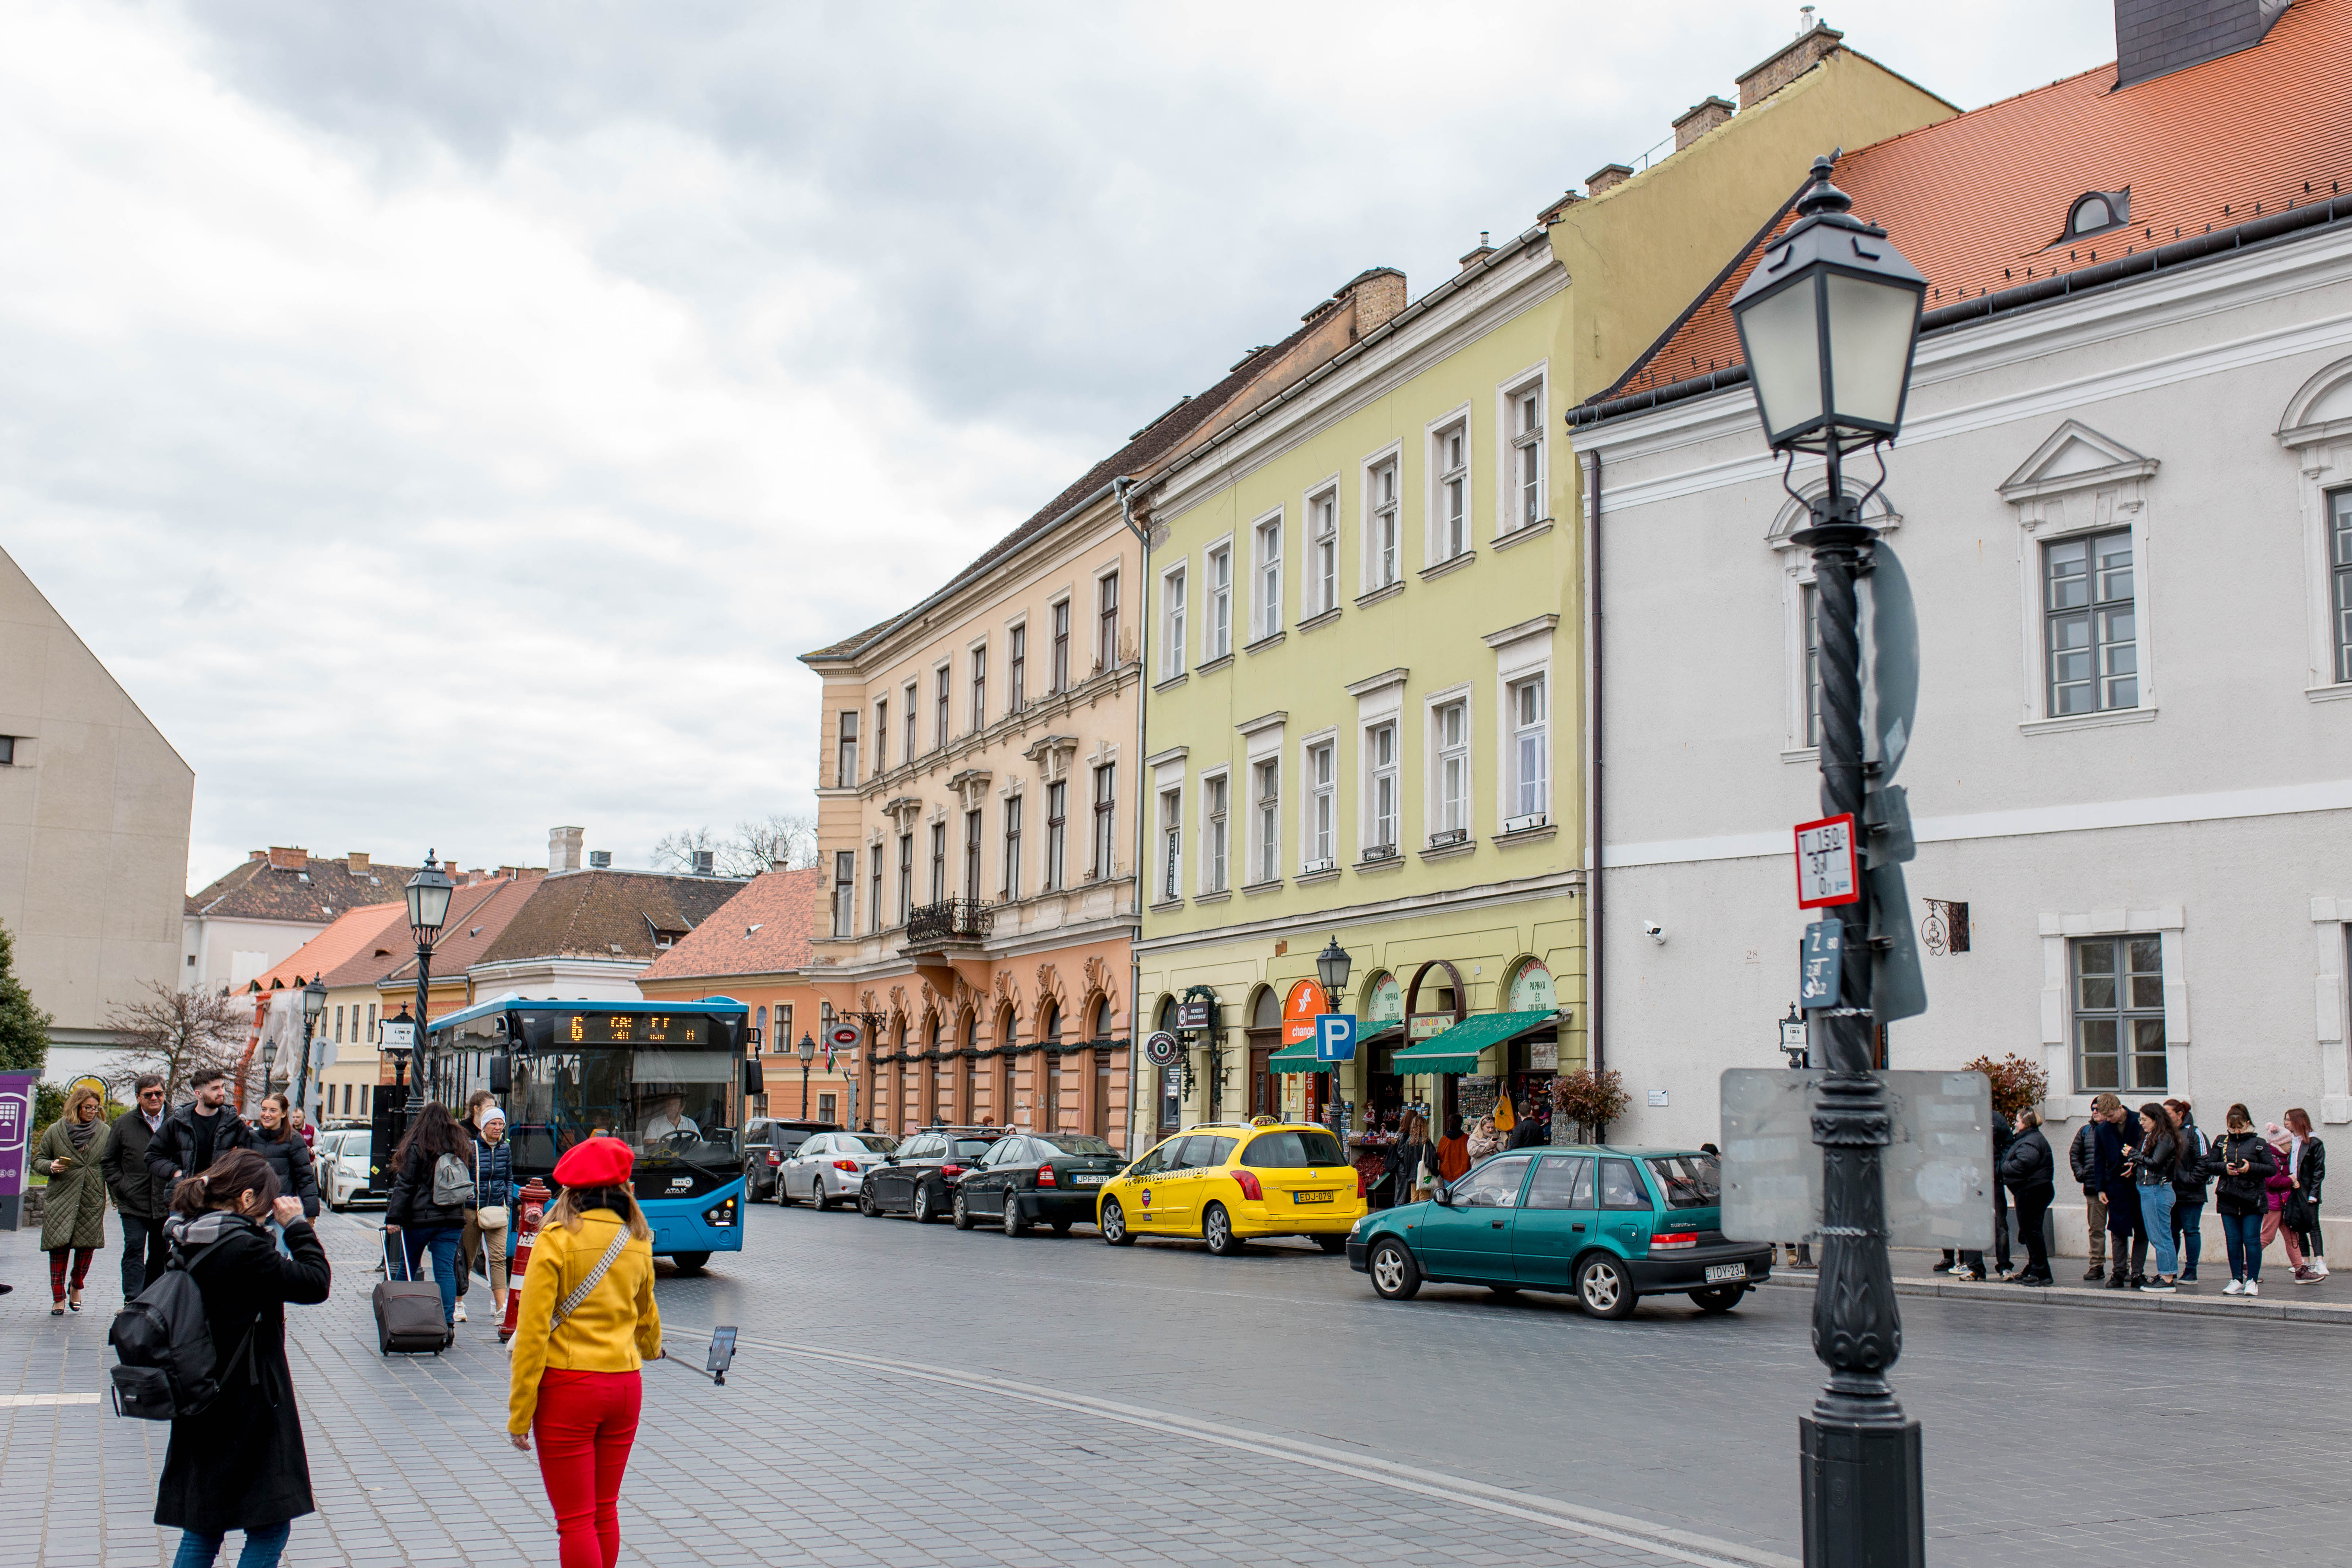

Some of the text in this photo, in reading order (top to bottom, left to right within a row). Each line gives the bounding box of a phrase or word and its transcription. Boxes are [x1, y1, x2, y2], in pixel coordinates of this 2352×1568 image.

[1817, 827, 1839, 849] 150
[1747, 950, 1758, 959] 28
[1530, 981, 1545, 990] PAPRIKA
[1385, 992, 1398, 1001] PAPRIKA
[1535, 991, 1540, 1002] ÉS
[1390, 1002, 1394, 1011] ÉS
[572, 1016, 583, 1041] 6
[1292, 1025, 1315, 1038] change
[1152, 1034, 1172, 1042] NEMZETI
[1325, 1019, 1350, 1056] P
[1148, 1051, 1175, 1063] DOHÁNYBOLT
[1300, 1192, 1331, 1201] EDJ-079
[1712, 1264, 1744, 1278] IDY-234
